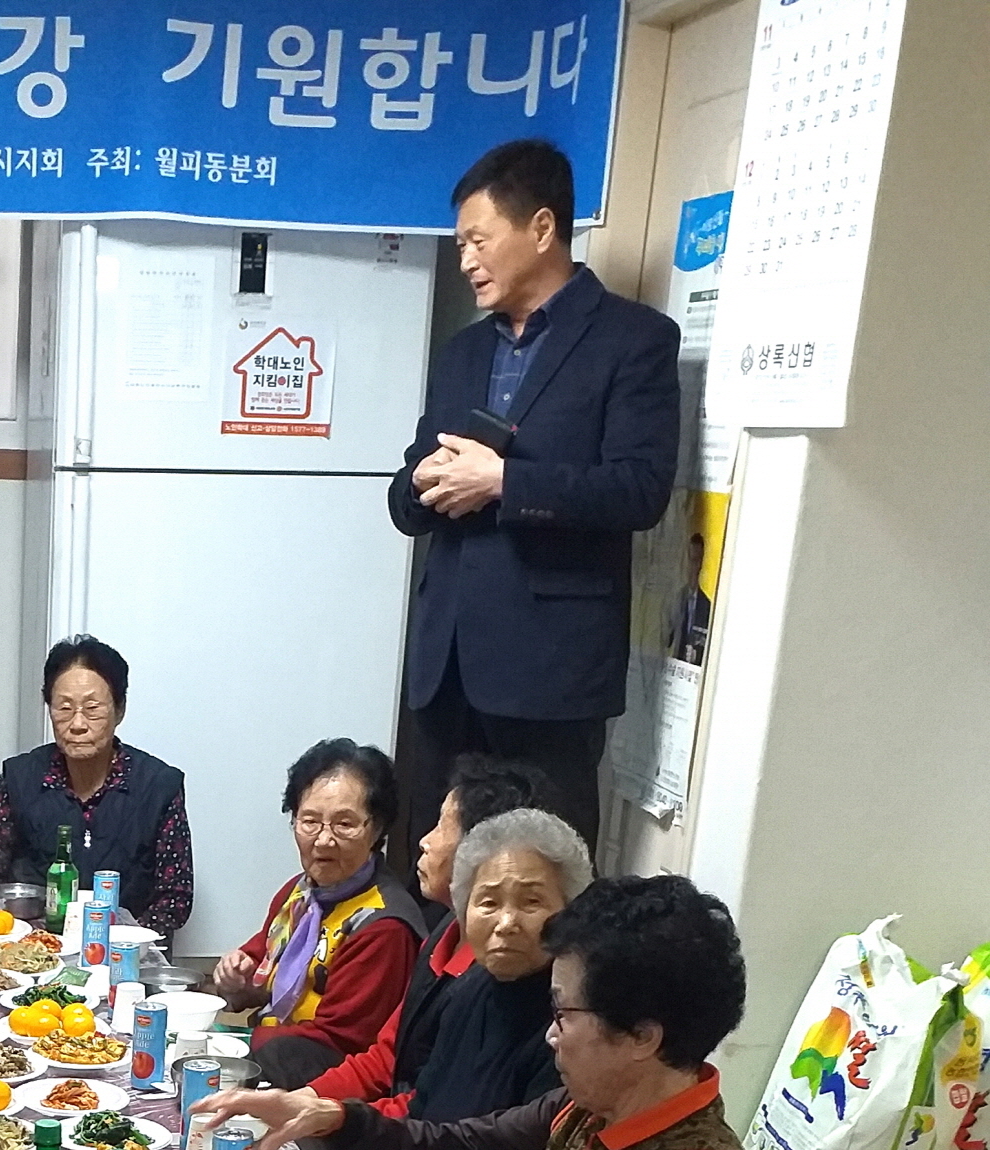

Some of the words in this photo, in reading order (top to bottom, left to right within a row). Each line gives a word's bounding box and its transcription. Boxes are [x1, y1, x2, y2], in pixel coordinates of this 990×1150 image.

[763, 24, 773, 42] 11
[161, 14, 588, 132] 기원합니다
[86, 145, 142, 178] 주최:
[154, 146, 278, 187] 월피동분회
[745, 160, 754, 177] 12
[254, 355, 305, 371] 학대노인
[758, 342, 815, 370] 상록신협
[252, 374, 304, 389] 지킴이집
